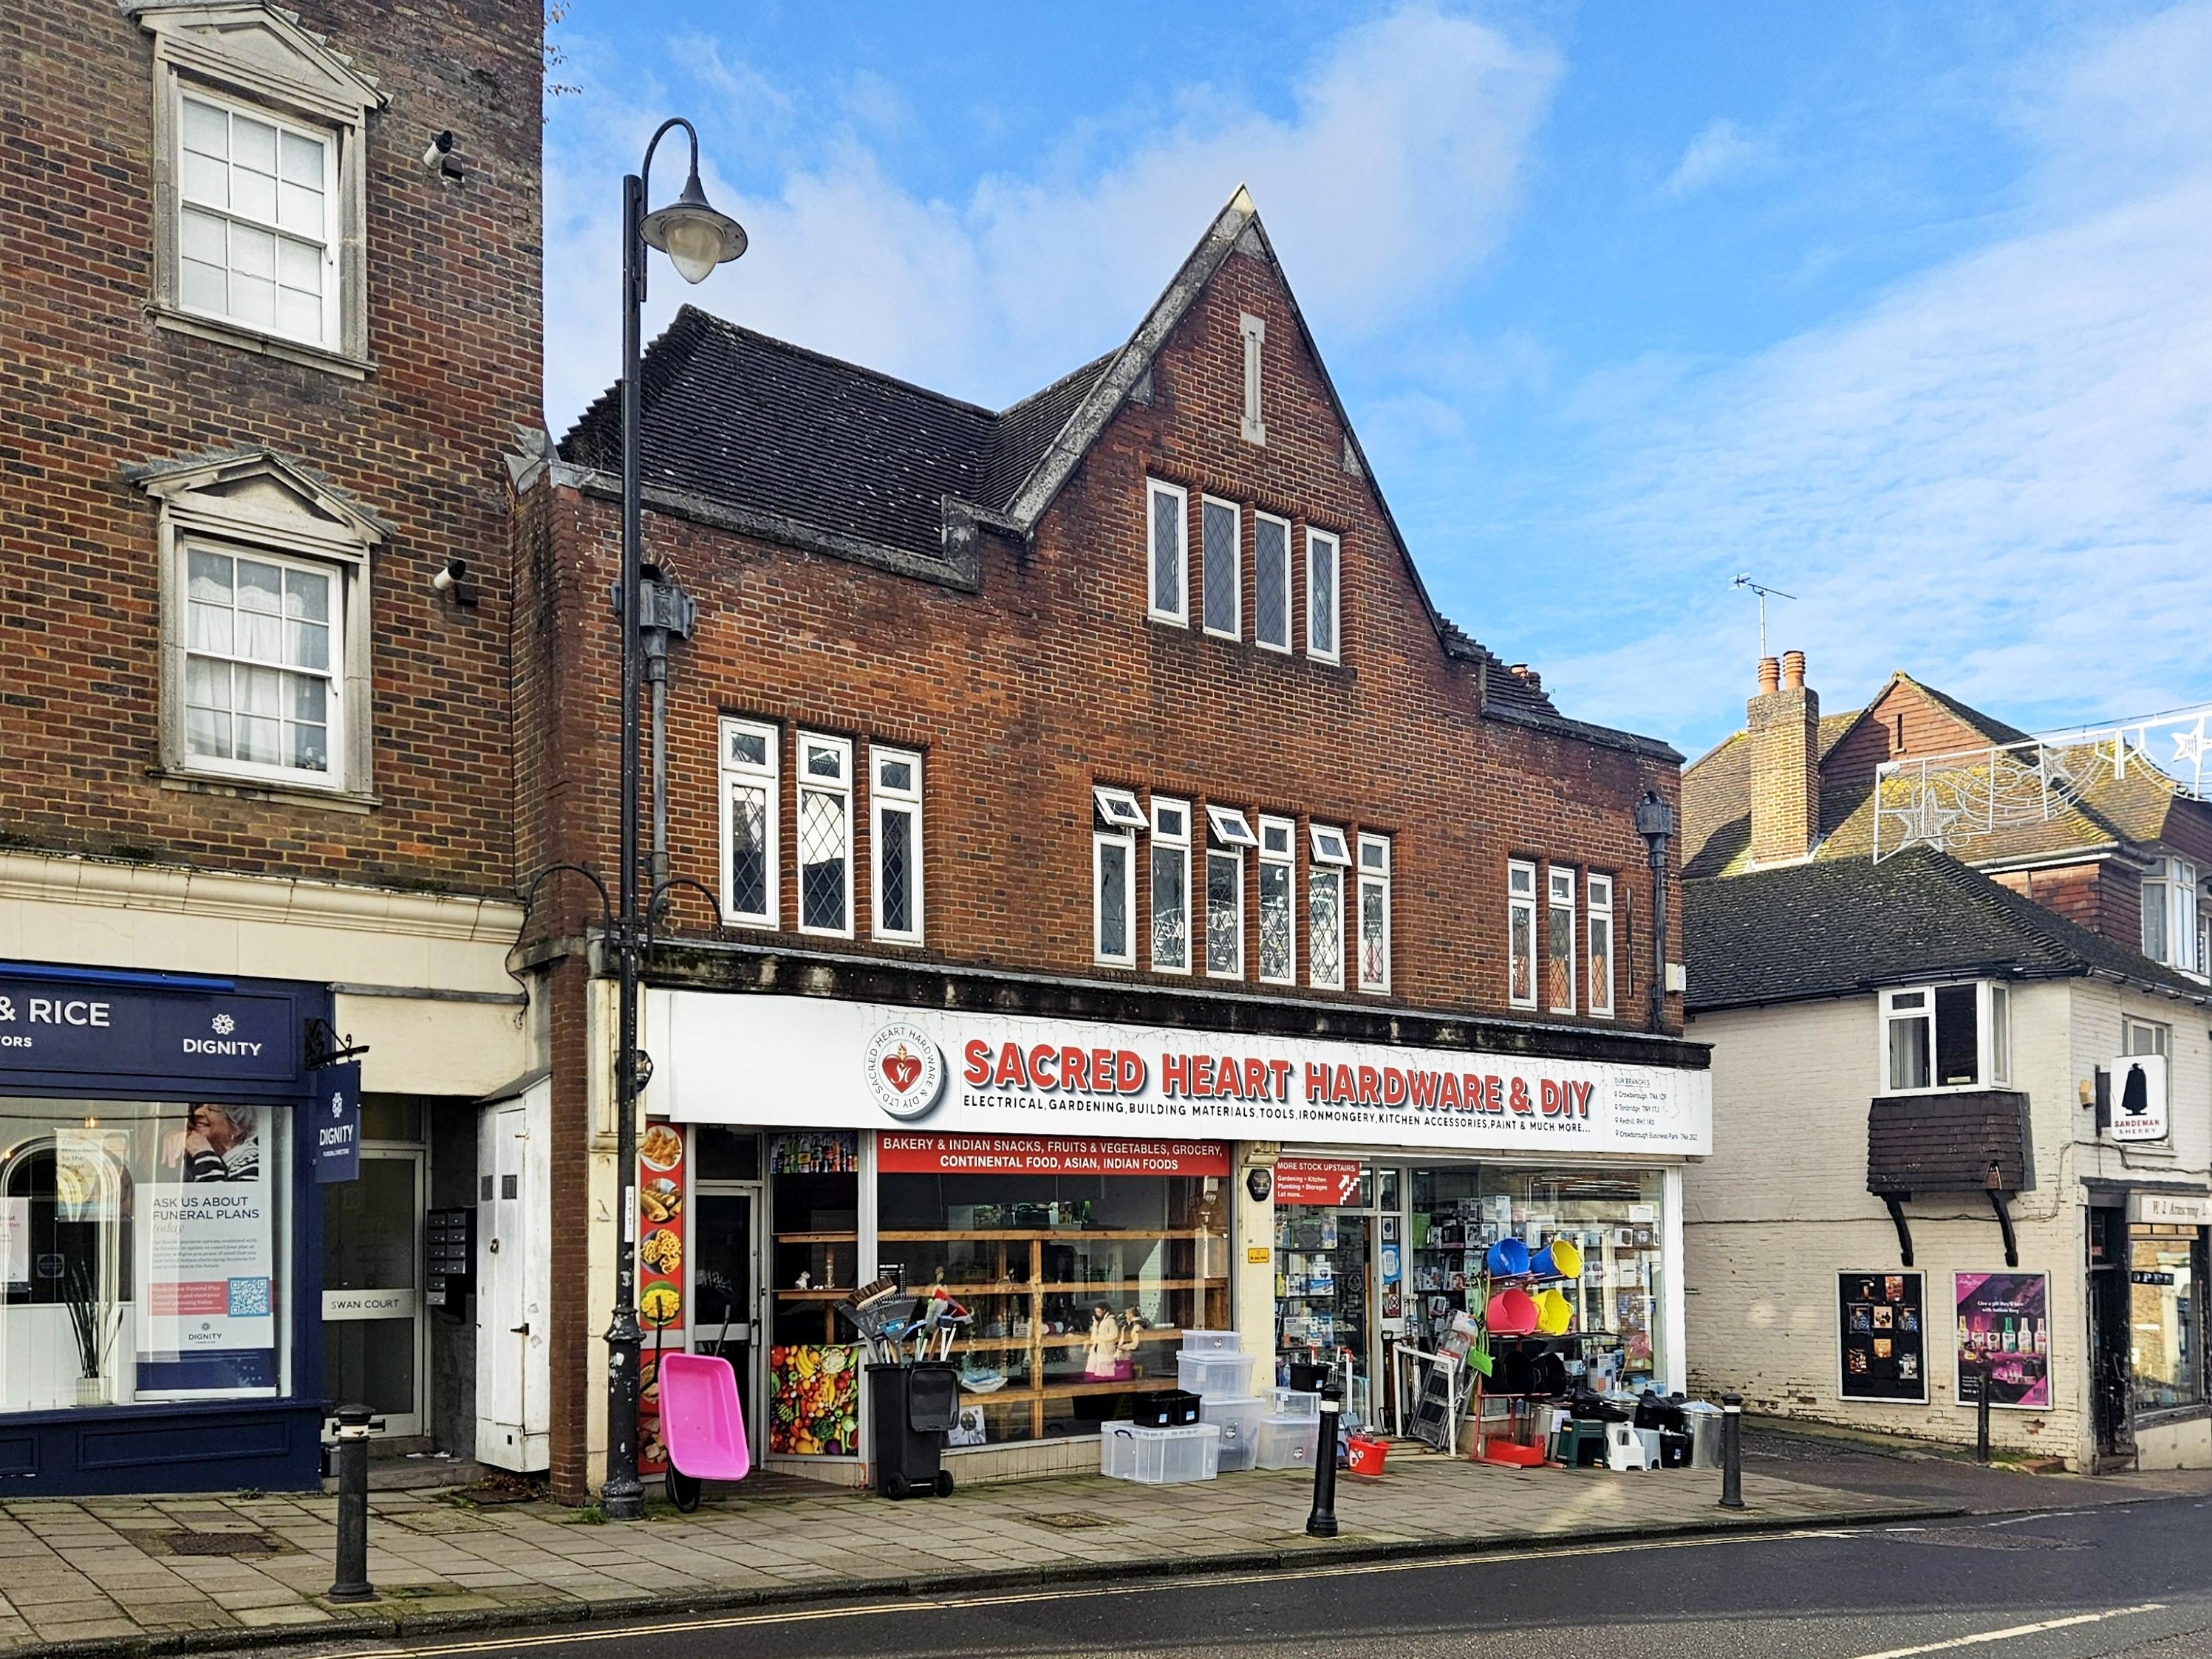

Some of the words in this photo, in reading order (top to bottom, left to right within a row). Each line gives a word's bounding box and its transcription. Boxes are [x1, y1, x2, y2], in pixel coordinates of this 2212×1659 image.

[0, 996, 16, 1021] &
[29, 998, 110, 1027] RICE
[0, 1036, 33, 1048] ORS
[875, 1027, 905, 1047] HEART
[182, 1039, 262, 1056] DIGNITY
[963, 1039, 1144, 1095] SACRED
[1161, 1053, 1291, 1103] HEART
[1305, 1061, 1502, 1112] HARDWARE
[1509, 1075, 1533, 1114] &
[1540, 1078, 1594, 1118] DIY
[1520, 1121, 1526, 1130] &
[1529, 1121, 1555, 1132] MUCH
[2114, 1119, 2160, 1128] SANDEMAN
[319, 1124, 354, 1146] DIGNITY
[883, 1138, 934, 1150] BAKERY
[938, 1139, 946, 1150] &
[949, 1139, 990, 1151] INDIAN
[994, 1140, 1045, 1154] SNACKS,
[1048, 1141, 1087, 1153] FRUITS
[1090, 1143, 1097, 1153] &
[1100, 1143, 1170, 1156] VEGETABLES,
[1172, 1144, 1223, 1157] GROCERY,
[940, 1155, 1023, 1168] CONTINENTAL
[1026, 1157, 1061, 1169] FOOD,
[1064, 1157, 1100, 1171] ASIAN,
[1103, 1158, 1139, 1169] INDIAN
[1143, 1159, 1178, 1170] FOODS
[1277, 1162, 1297, 1170] MORE
[1299, 1163, 1322, 1171] STOCK
[1323, 1163, 1356, 1172] UPSTAIRS
[153, 1198, 177, 1208] ASK
[181, 1197, 199, 1207] US
[202, 1197, 249, 1207] ABOUT
[153, 1210, 214, 1220] FUNERAL
[216, 1209, 259, 1219] PLANS
[2132, 1272, 2173, 1283] OPEN
[331, 1301, 361, 1310] SWAN
[364, 1299, 400, 1309] COURT
